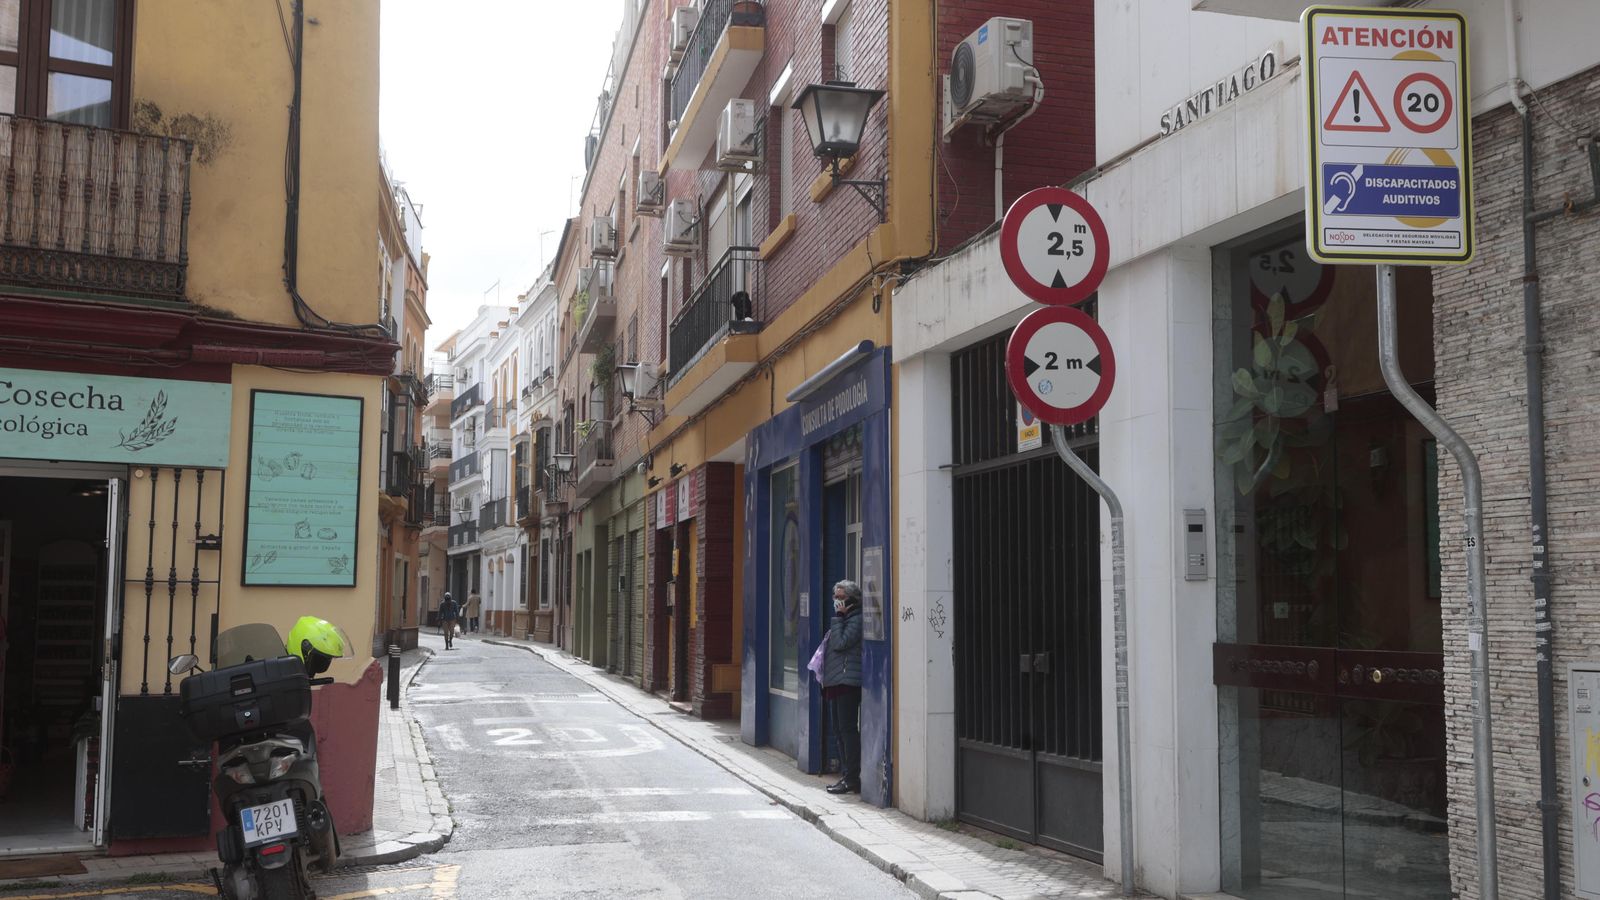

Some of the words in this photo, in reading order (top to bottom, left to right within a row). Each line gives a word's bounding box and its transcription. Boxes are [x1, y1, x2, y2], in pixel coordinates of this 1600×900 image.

[1321, 25, 1454, 49] ATENCIÓN
[1160, 52, 1276, 138] SANTIAGO
[1406, 92, 1440, 113] 20
[1365, 178, 1457, 190] DISCAPACITADOS
[1382, 194, 1441, 206] AUDITIVOS
[1073, 223, 1087, 234] m
[1047, 231, 1084, 261] 2,5
[1044, 351, 1059, 370] 2
[1066, 357, 1083, 370] m
[0, 414, 89, 440] ológica
[253, 803, 289, 823] 7201
[255, 818, 283, 838] KPV
